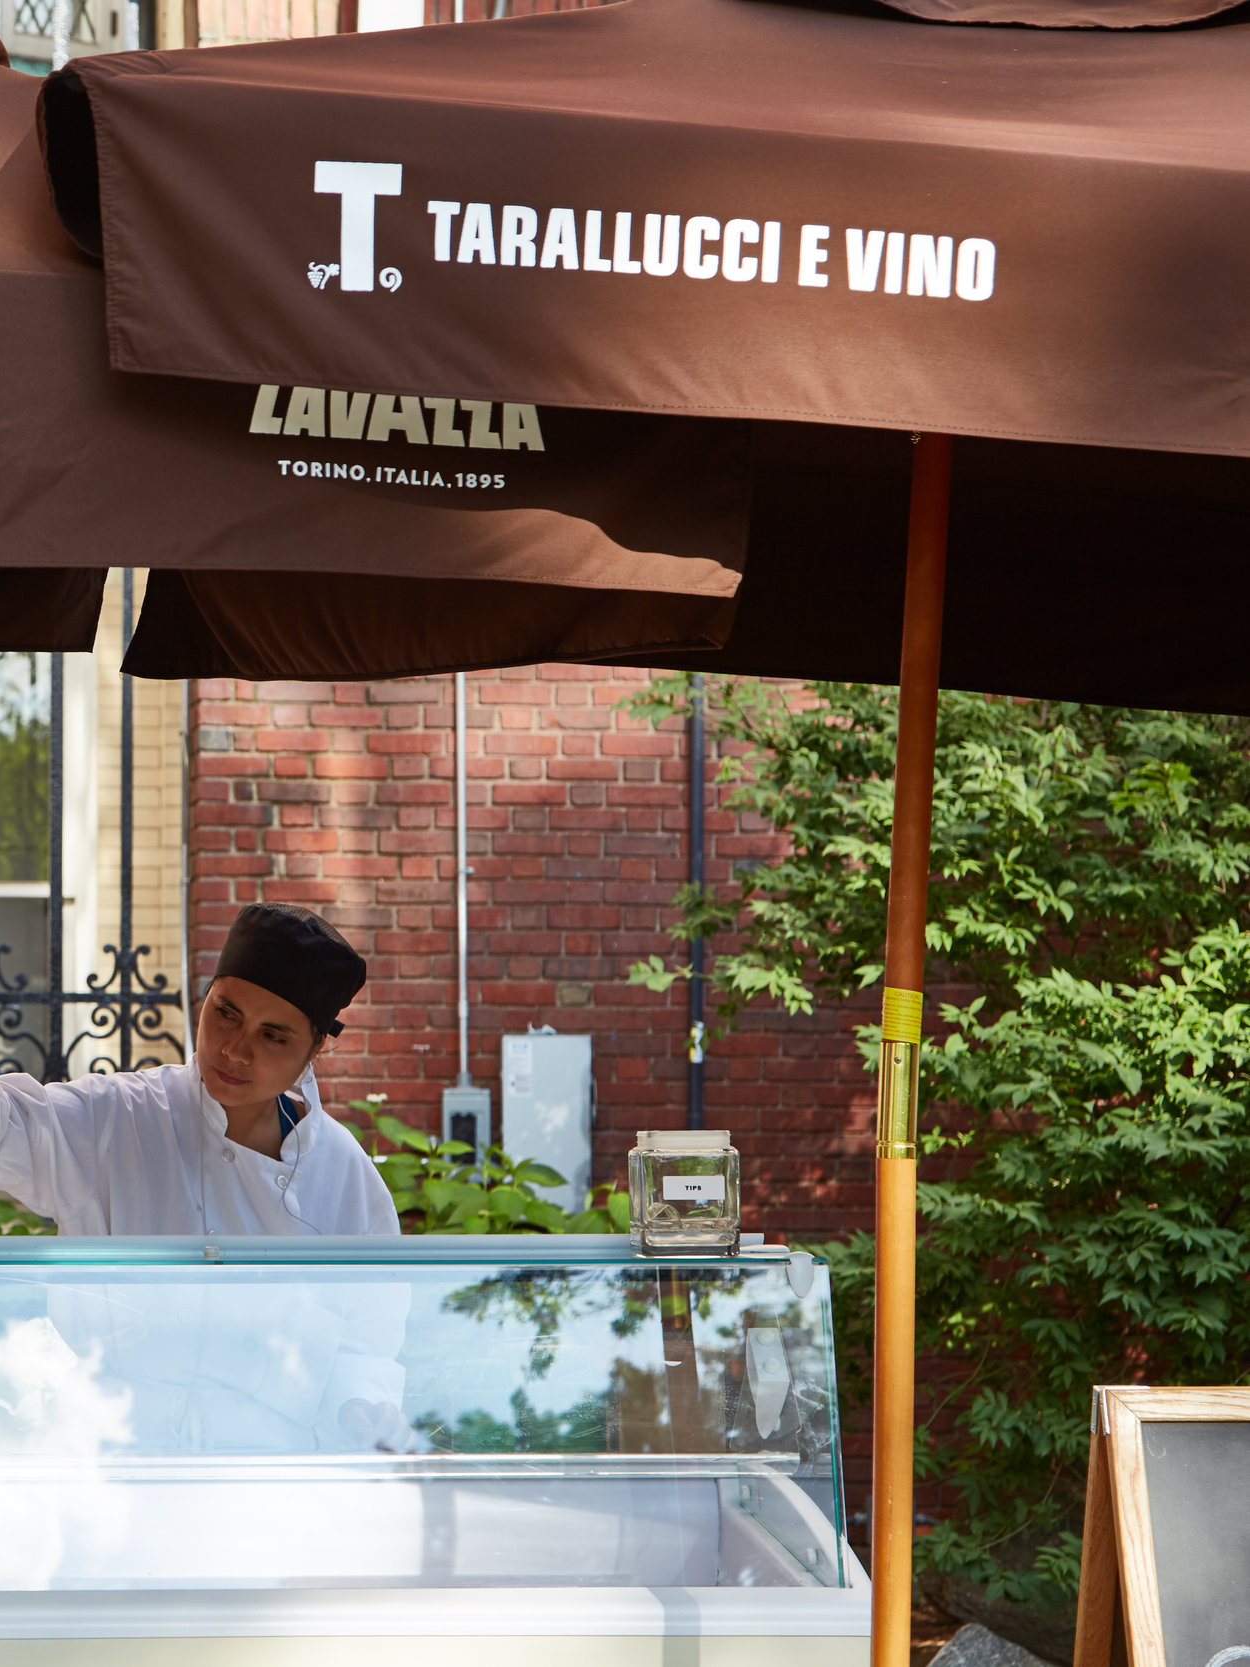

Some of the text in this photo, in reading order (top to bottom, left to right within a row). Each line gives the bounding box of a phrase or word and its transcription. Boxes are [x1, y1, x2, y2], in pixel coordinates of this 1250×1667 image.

[427, 200, 996, 302] TARALLUCCI E VINO
[249, 384, 545, 451] LAVAZZA
[455, 472, 505, 490] 1895
[894, 991, 919, 1000] CAUTION
